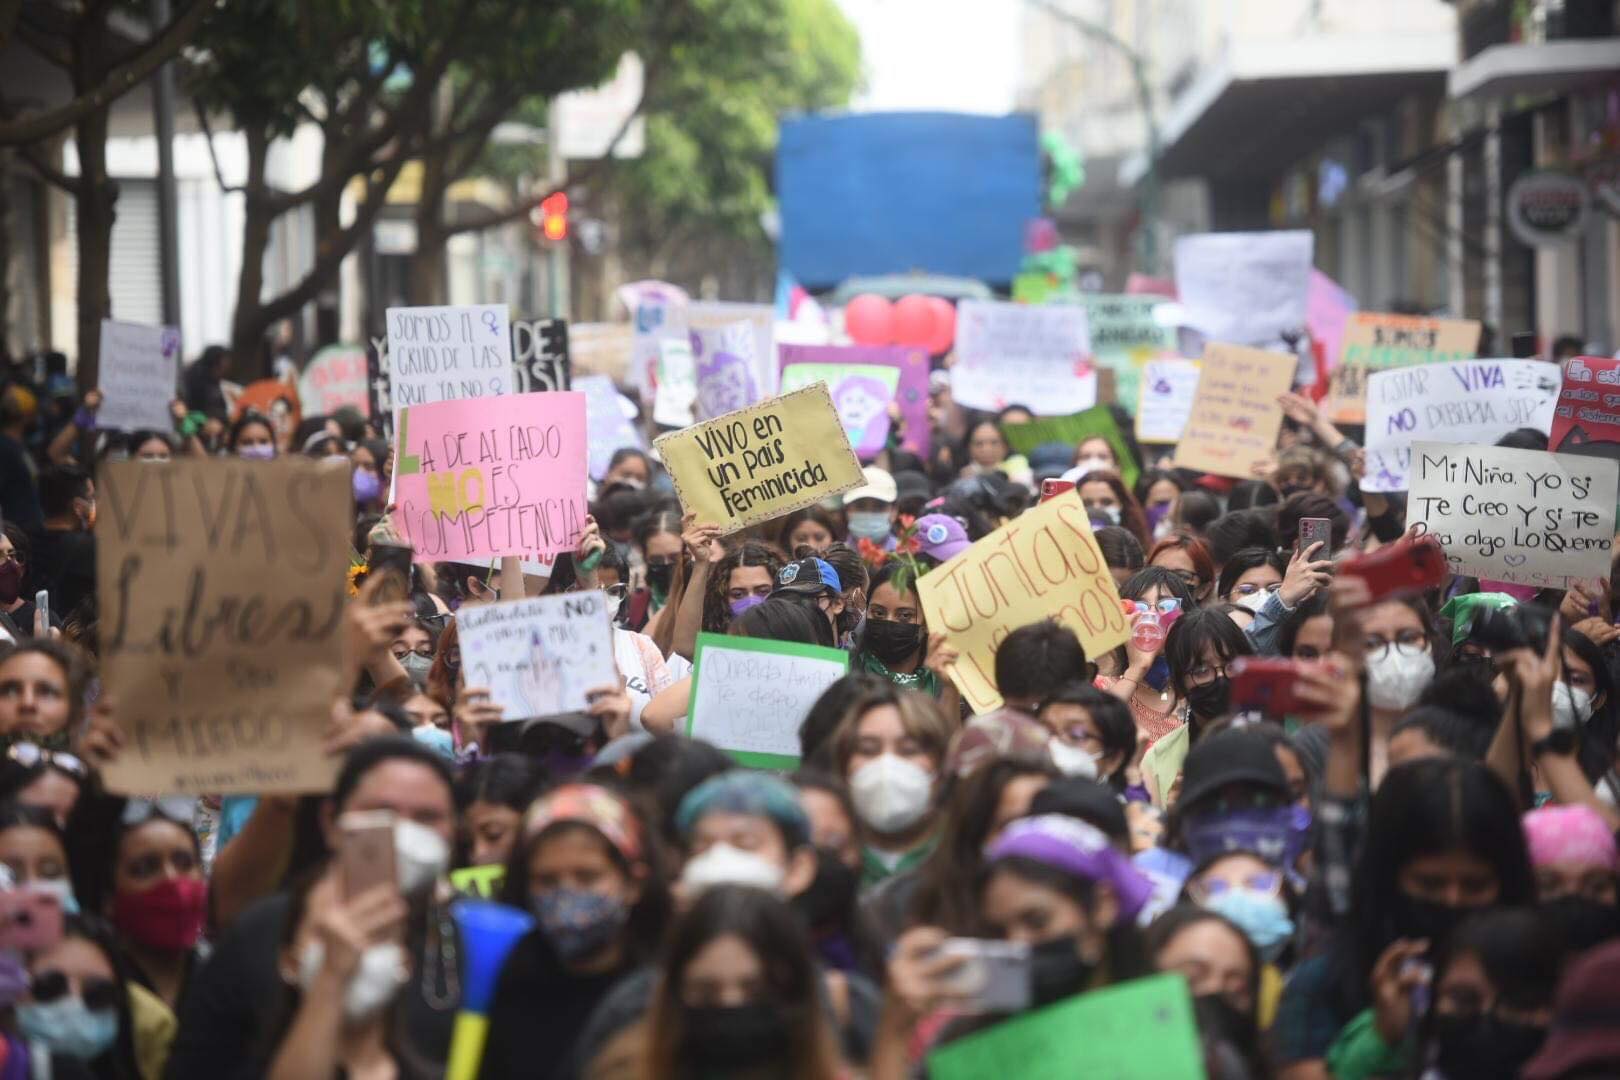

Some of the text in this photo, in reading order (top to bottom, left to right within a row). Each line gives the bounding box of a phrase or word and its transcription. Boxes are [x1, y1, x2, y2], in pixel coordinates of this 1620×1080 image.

[394, 312, 451, 343] SOMOS
[471, 346, 502, 369] LAS
[1452, 365, 1505, 392] VIVA
[753, 414, 783, 440] en
[1387, 407, 1417, 435] NO
[442, 432, 472, 469] DE
[479, 429, 502, 463] AL
[509, 424, 561, 462] LADO
[707, 461, 741, 488] un
[1422, 453, 1456, 483] Mi
[427, 463, 521, 520] NO ES
[100, 462, 335, 578] VIVAS
[1416, 496, 1452, 521] Te
[1462, 494, 1509, 516] Creo
[1516, 503, 1538, 527] Y
[1572, 510, 1600, 529] Te
[1465, 528, 1505, 557] algo
[1544, 531, 1612, 553] Quemo
[101, 552, 344, 657] Libres
[563, 595, 597, 620] NO
